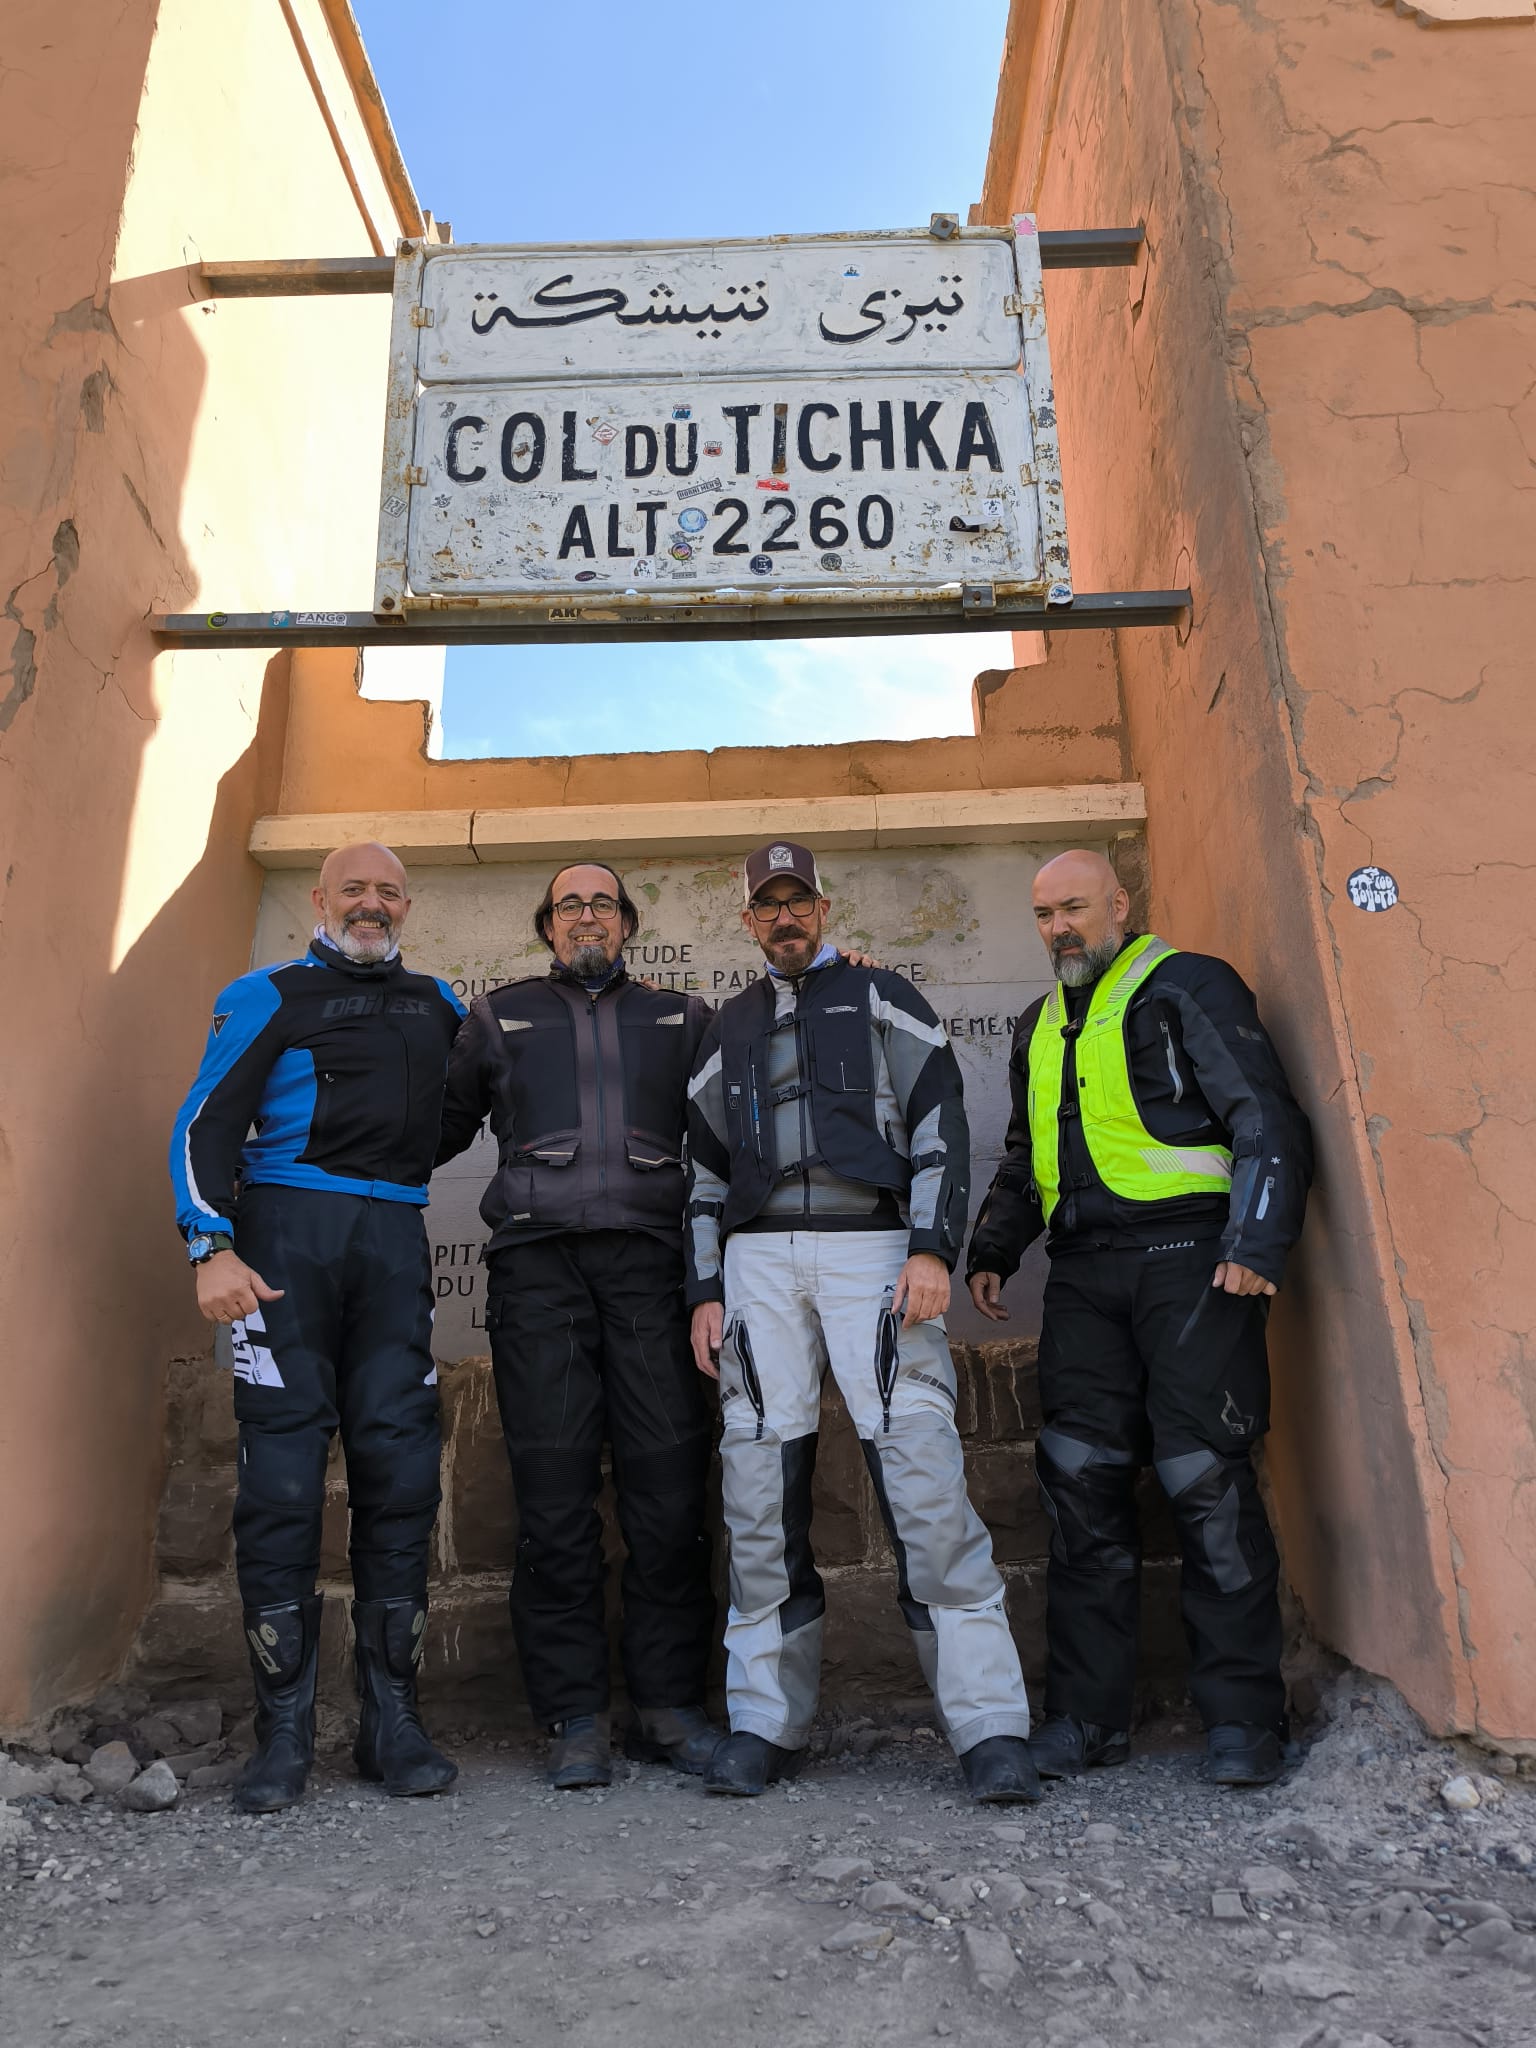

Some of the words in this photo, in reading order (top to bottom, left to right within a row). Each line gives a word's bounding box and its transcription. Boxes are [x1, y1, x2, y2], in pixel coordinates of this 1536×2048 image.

[446, 411, 598, 483] COL
[625, 422, 698, 477] DU
[721, 400, 1004, 475] TICHKA
[558, 501, 668, 559] ALT
[712, 493, 894, 556] 2260
[450, 978, 515, 998] OUT
[713, 969, 758, 990] PAR
[437, 1275, 474, 1299] DU
